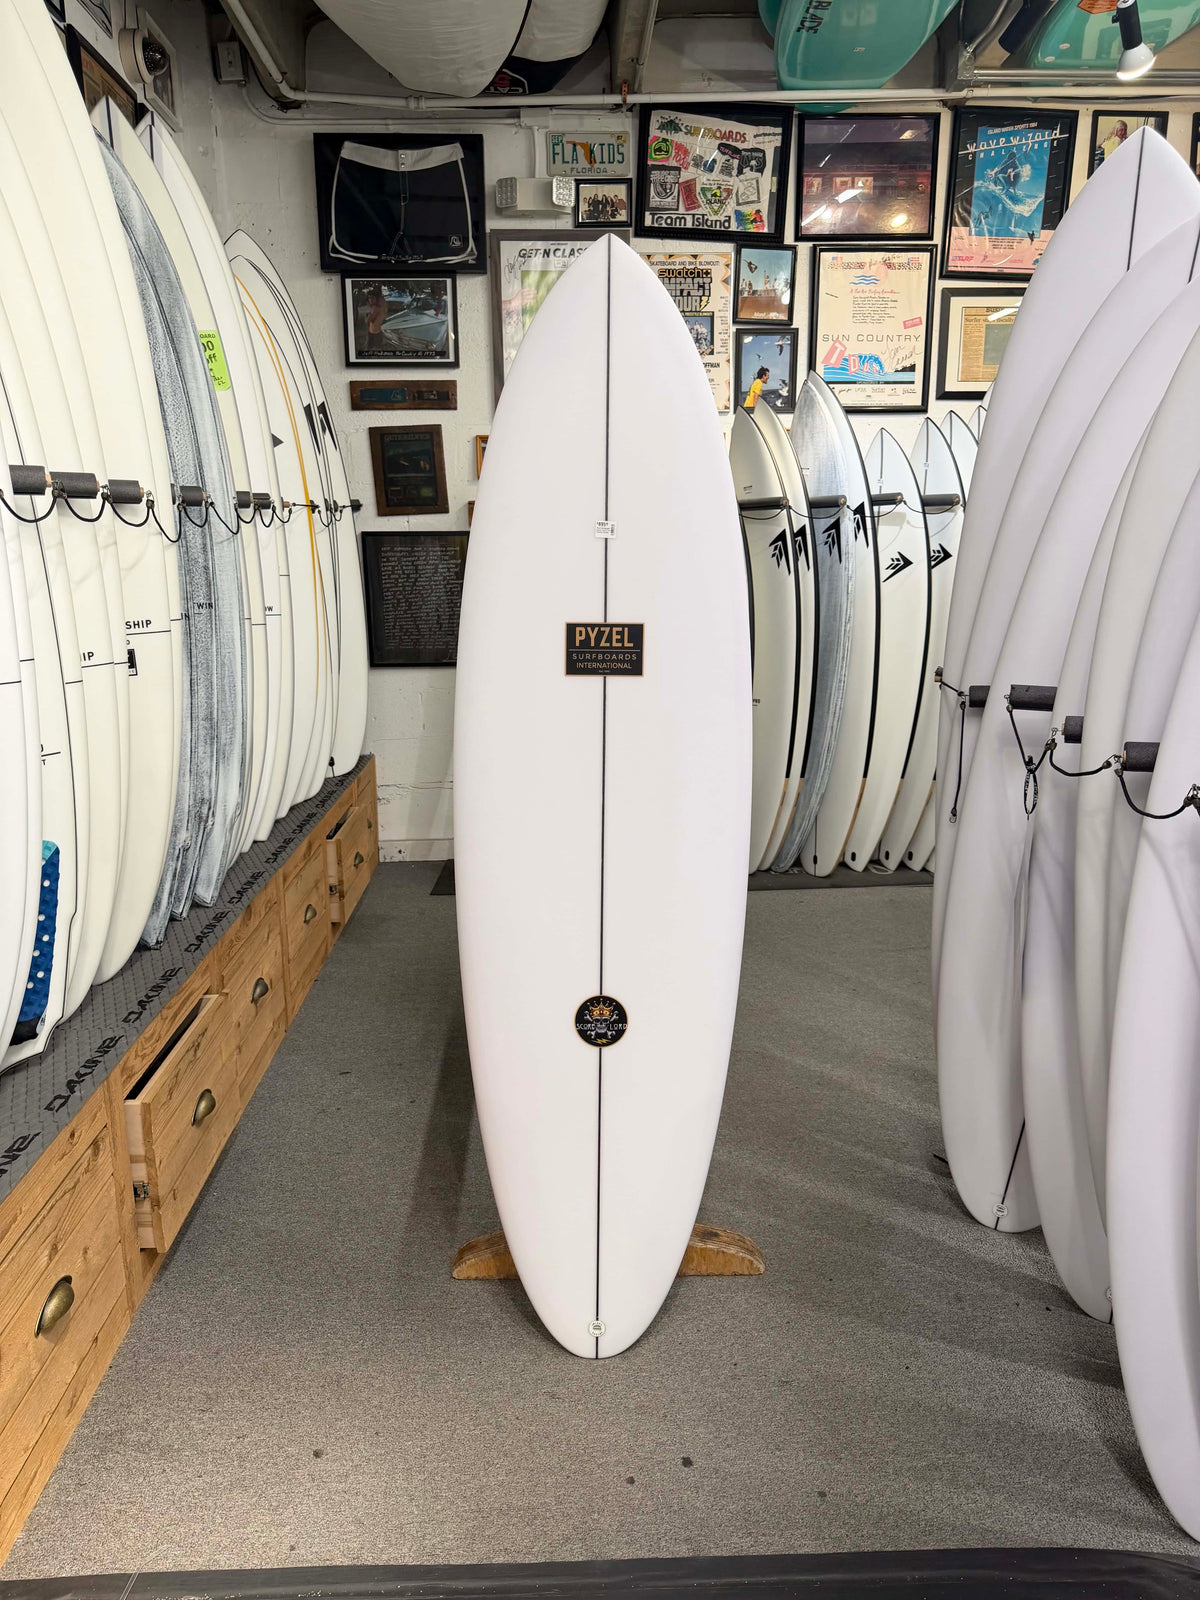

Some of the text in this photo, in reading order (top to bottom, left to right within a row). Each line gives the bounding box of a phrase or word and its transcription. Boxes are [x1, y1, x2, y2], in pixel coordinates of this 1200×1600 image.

[589, 143, 625, 164] KIDS
[968, 140, 1058, 160] CHALLENGE
[649, 213, 732, 230] Team Island
[672, 296, 701, 311] OUR
[857, 334, 921, 342] COUNTRY
[125, 620, 152, 630] SHIP
[575, 627, 634, 647] PYZEL
